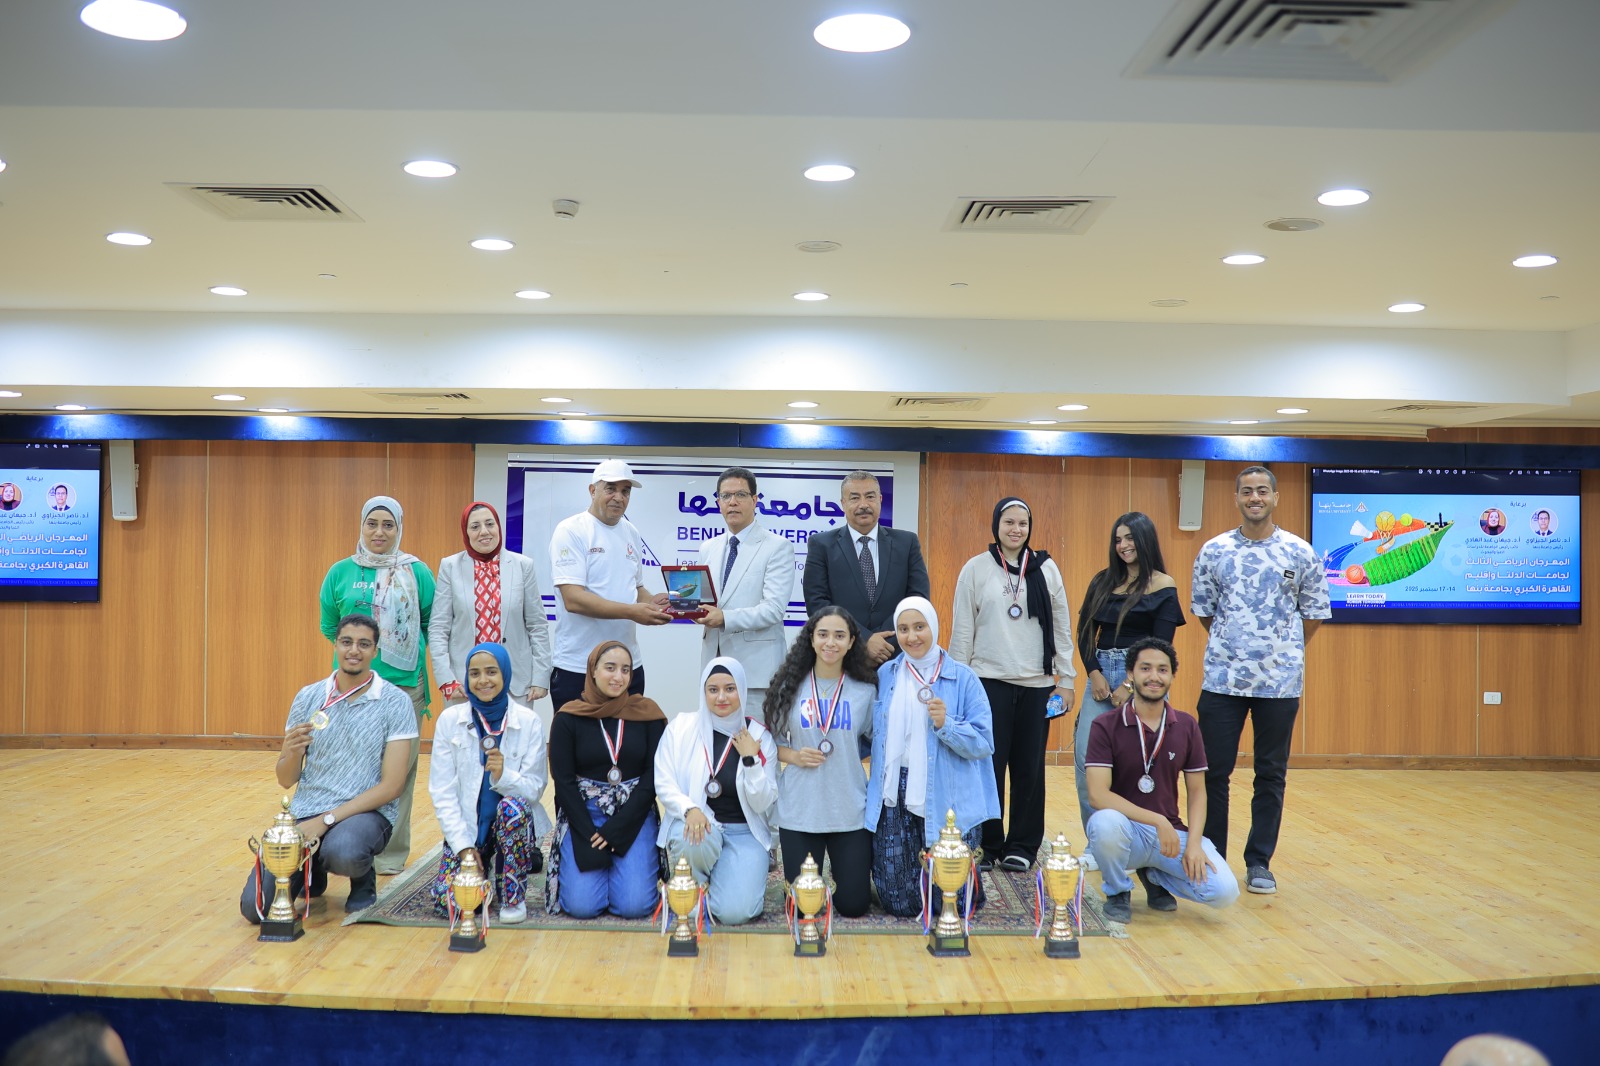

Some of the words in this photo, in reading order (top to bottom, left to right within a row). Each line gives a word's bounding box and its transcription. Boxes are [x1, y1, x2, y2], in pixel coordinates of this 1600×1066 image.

[677, 526, 725, 541] BENH
[7, 534, 44, 545] الرياضي
[45, 534, 88, 543] المهرجان
[11, 547, 41, 555] الدلتا
[41, 547, 87, 557] لجامعات
[1465, 556, 1492, 565] الثالث
[1492, 558, 1528, 569] الرياضي
[1529, 558, 1570, 567] المهرجان
[58, 561, 89, 571] القاهرة
[1464, 571, 1496, 581] وإقليم
[1497, 571, 1525, 579] الدلتا
[1526, 571, 1570, 581] لجامعات
[352, 581, 368, 589] LOS
[1466, 585, 1483, 594] بنها
[1483, 585, 1513, 594] بجامعة
[1541, 585, 1571, 594] القاهرة
[816, 698, 852, 730] NBA
